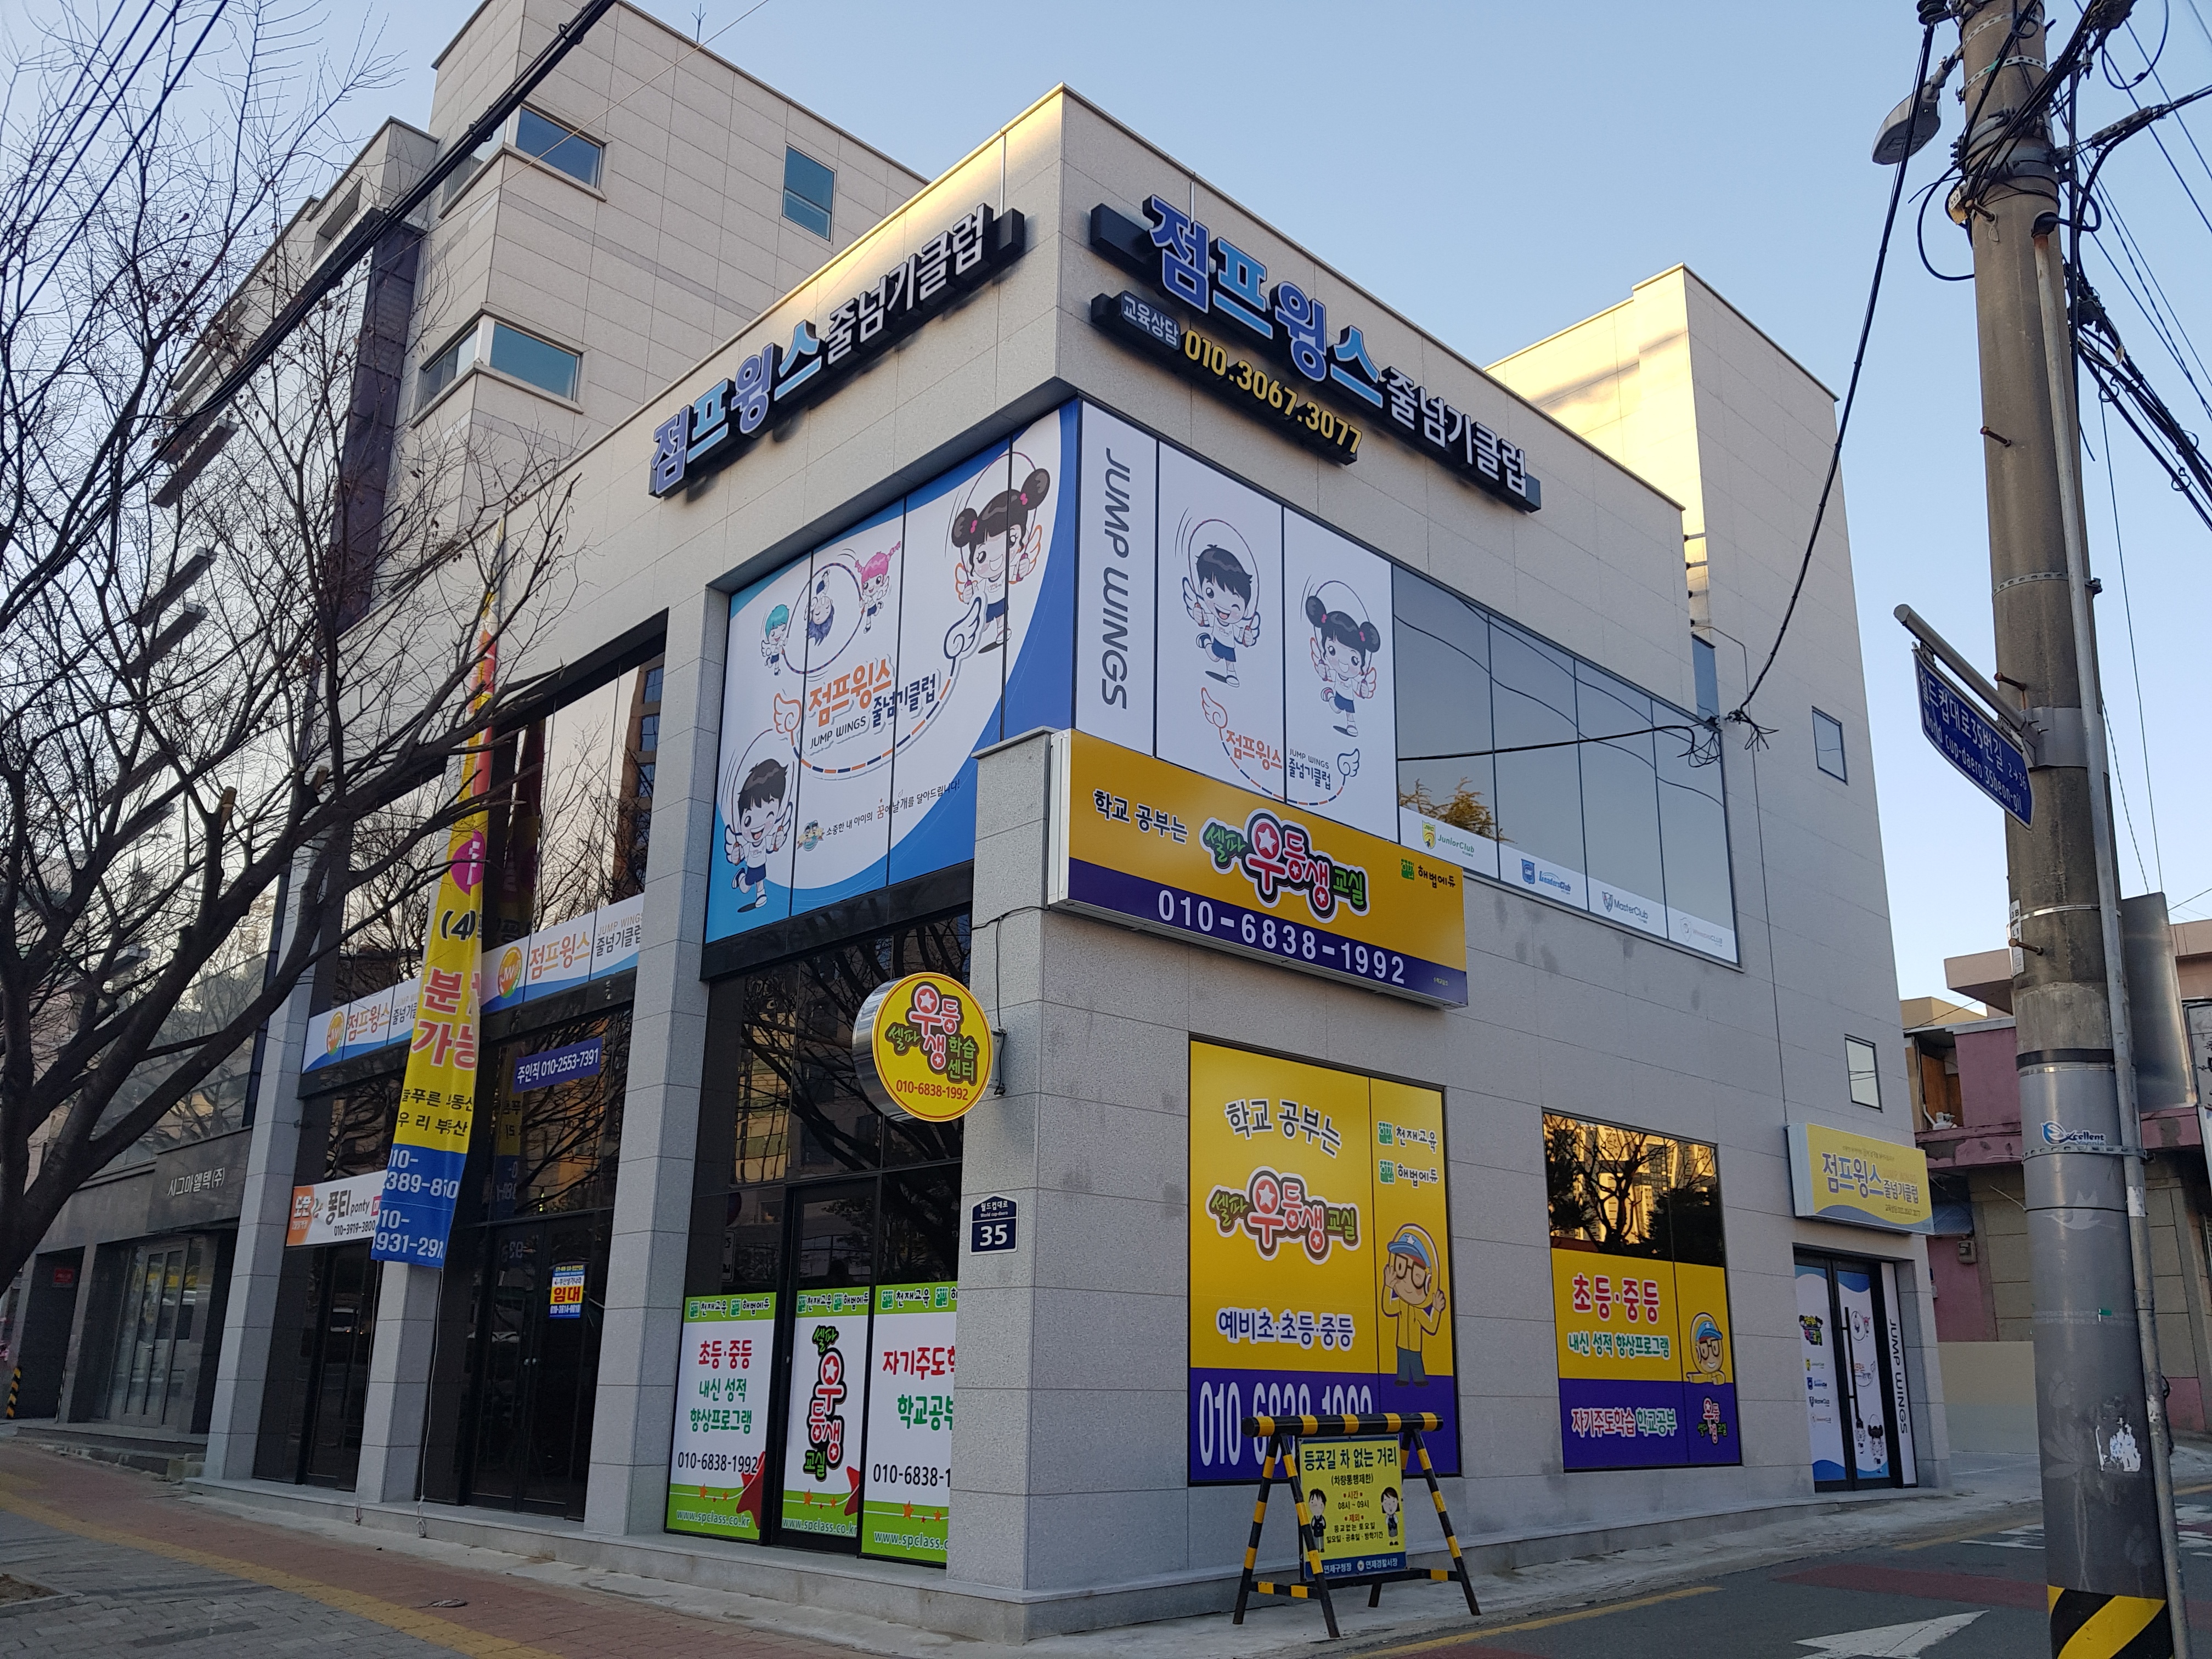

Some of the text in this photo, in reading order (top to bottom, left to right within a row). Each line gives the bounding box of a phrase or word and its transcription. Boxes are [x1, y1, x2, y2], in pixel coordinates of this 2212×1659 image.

[1123, 295, 1180, 346] 교육상담
[651, 203, 986, 494] 점프윙스 줄넘기클럽
[1148, 194, 1528, 499] 점프윙스 줄넘기클럽
[1184, 329, 1363, 455] 010.3067.3077
[1102, 447, 1130, 710] JUMP WINGS
[809, 658, 892, 727] 점프윙스
[872, 673, 936, 729] 줄넘기클럽
[810, 716, 867, 749] JUMP WINGS
[1226, 730, 1283, 771] 점프윙스
[1289, 748, 1330, 769] JUMP WINGS
[1923, 706, 2023, 814] World cup-daero 35beon-gil
[1289, 758, 1331, 791] 줄넘기클럽
[826, 823, 845, 836] 소중한
[847, 819, 853, 830] 내
[854, 811, 873, 827] 아이의
[1093, 788, 1188, 844] 학교 공부는
[1438, 834, 1475, 853] JuniorClub
[1333, 868, 1367, 908] 교실
[1418, 865, 1456, 889] 해법에듀
[1614, 899, 1649, 919] MasterClub
[598, 912, 642, 936] JUMP WING
[1158, 889, 1405, 985] 010-6838-1992
[529, 932, 590, 980] 점프윙스
[347, 1002, 390, 1042] 점프윙스
[948, 1036, 977, 1060] 학습
[517, 1047, 599, 1084] 주인직 010-2553-7391
[947, 1059, 974, 1081] 센터
[895, 1079, 969, 1101] 010-6838-1992
[1225, 1099, 1341, 1158] 학교 공부는
[1396, 1126, 1437, 1153] 천재교육
[1397, 1164, 1438, 1187] 해법에듀
[1821, 1152, 1883, 1199] 점프윙스
[350, 1199, 370, 1217] ponty
[980, 1200, 1008, 1212] 월드컵대로
[334, 1220, 376, 1236] 010-3919-3800
[979, 1224, 1007, 1246] 35
[1327, 1209, 1356, 1240] 교실
[554, 1286, 580, 1302] 임대
[807, 1294, 869, 1312] 천재교육 해법에듀
[896, 1289, 930, 1308] 천재교육
[701, 1298, 770, 1317] 천재교육 해법에듀
[1568, 1332, 1669, 1358] 내신 성적 향상프로그램
[1889, 1318, 1909, 1435] JUMP WINGS
[699, 1378, 747, 1402] 내신 성적
[690, 1408, 752, 1435] 향상프로그램
[1572, 1409, 1635, 1436] 자기주도학습
[1636, 1409, 1677, 1435] 학교공부
[678, 1452, 758, 1474] 010-6838-1992
[1340, 1448, 1350, 1469] 차
[1353, 1448, 1374, 1469] 없는
[1377, 1447, 1398, 1467] 거리
[1347, 1491, 1359, 1499] 시간
[677, 1510, 750, 1527] www.spclass.co.kr
